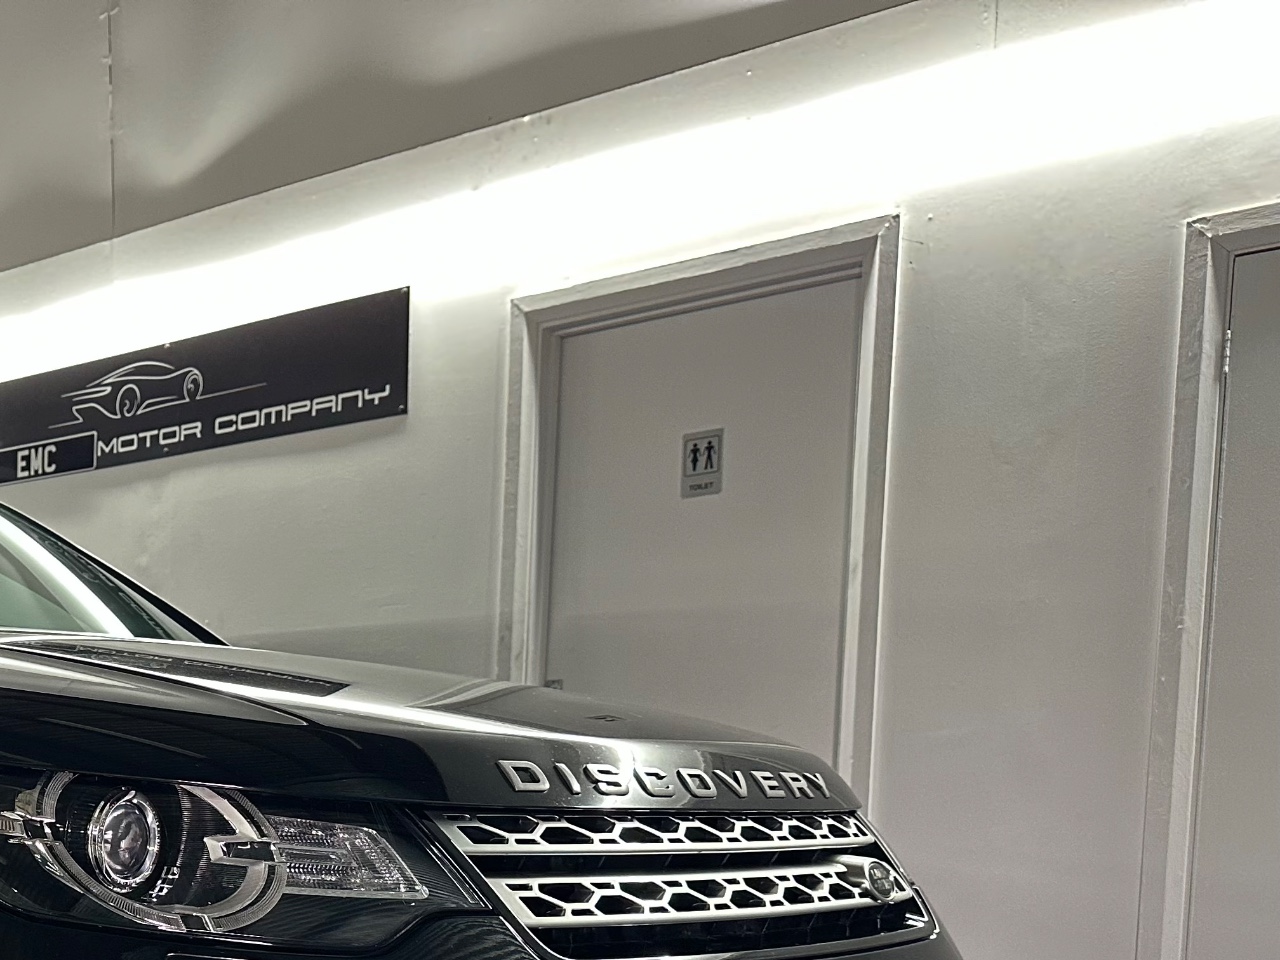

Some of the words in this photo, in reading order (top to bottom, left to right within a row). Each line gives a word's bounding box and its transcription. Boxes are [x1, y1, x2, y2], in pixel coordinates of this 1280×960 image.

[16, 445, 58, 478] EMC
[98, 421, 202, 457] MOTOR
[214, 384, 391, 436] COMPANY
[496, 759, 831, 799] DISCOVERY
